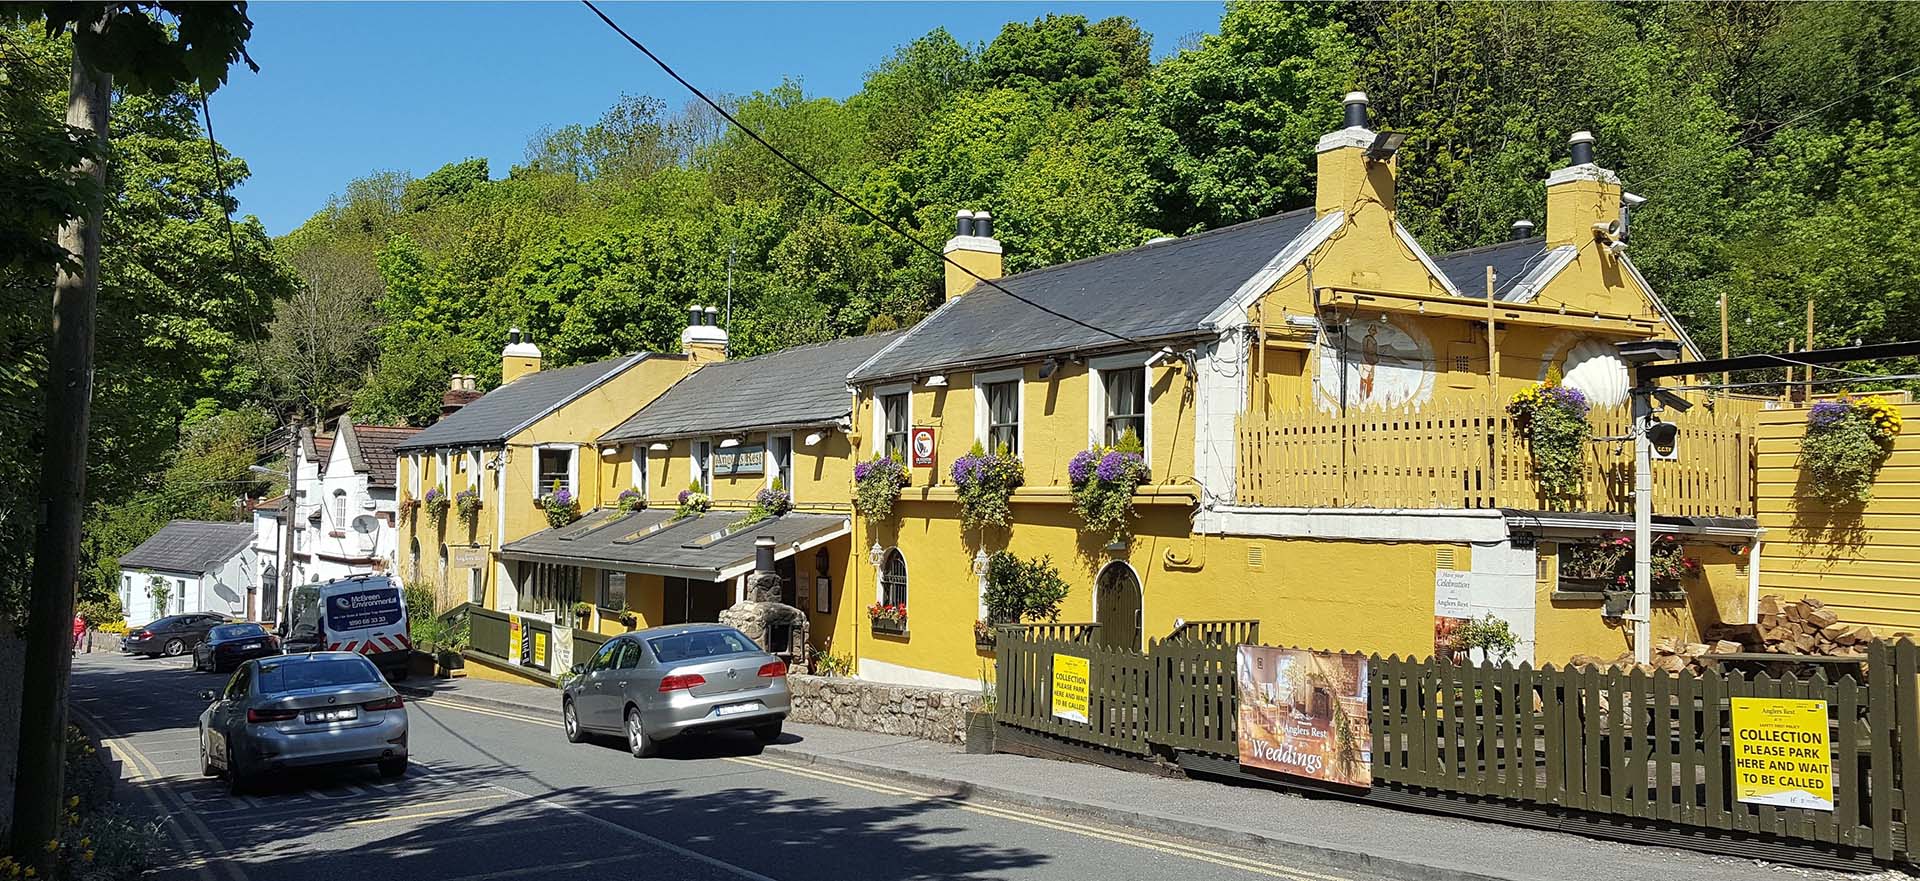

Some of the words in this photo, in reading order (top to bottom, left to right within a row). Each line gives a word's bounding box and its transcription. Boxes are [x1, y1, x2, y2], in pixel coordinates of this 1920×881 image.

[1437, 579, 1470, 589] Celebration
[352, 594, 380, 602] McBreen
[352, 597, 397, 608] Environmental
[1056, 673, 1086, 685] COLLECTION
[1056, 682, 1072, 690] PLEASE
[1073, 685, 1085, 693] PARK
[1068, 701, 1086, 711] CALLED
[1761, 707, 1782, 715] Anglers
[1284, 724, 1310, 736] Anglers
[1311, 727, 1328, 737] Rest
[1740, 729, 1822, 744] COLLECTION
[1251, 739, 1322, 774] Weddings
[1743, 745, 1785, 756] PLEASE
[1789, 747, 1820, 759] PARK
[1737, 758, 1765, 769] HERE
[1769, 761, 1795, 771] AND
[1798, 763, 1829, 774] WAIT
[1743, 773, 1758, 783] TO
[1761, 775, 1775, 785] BE
[1779, 776, 1824, 789] CALLED
